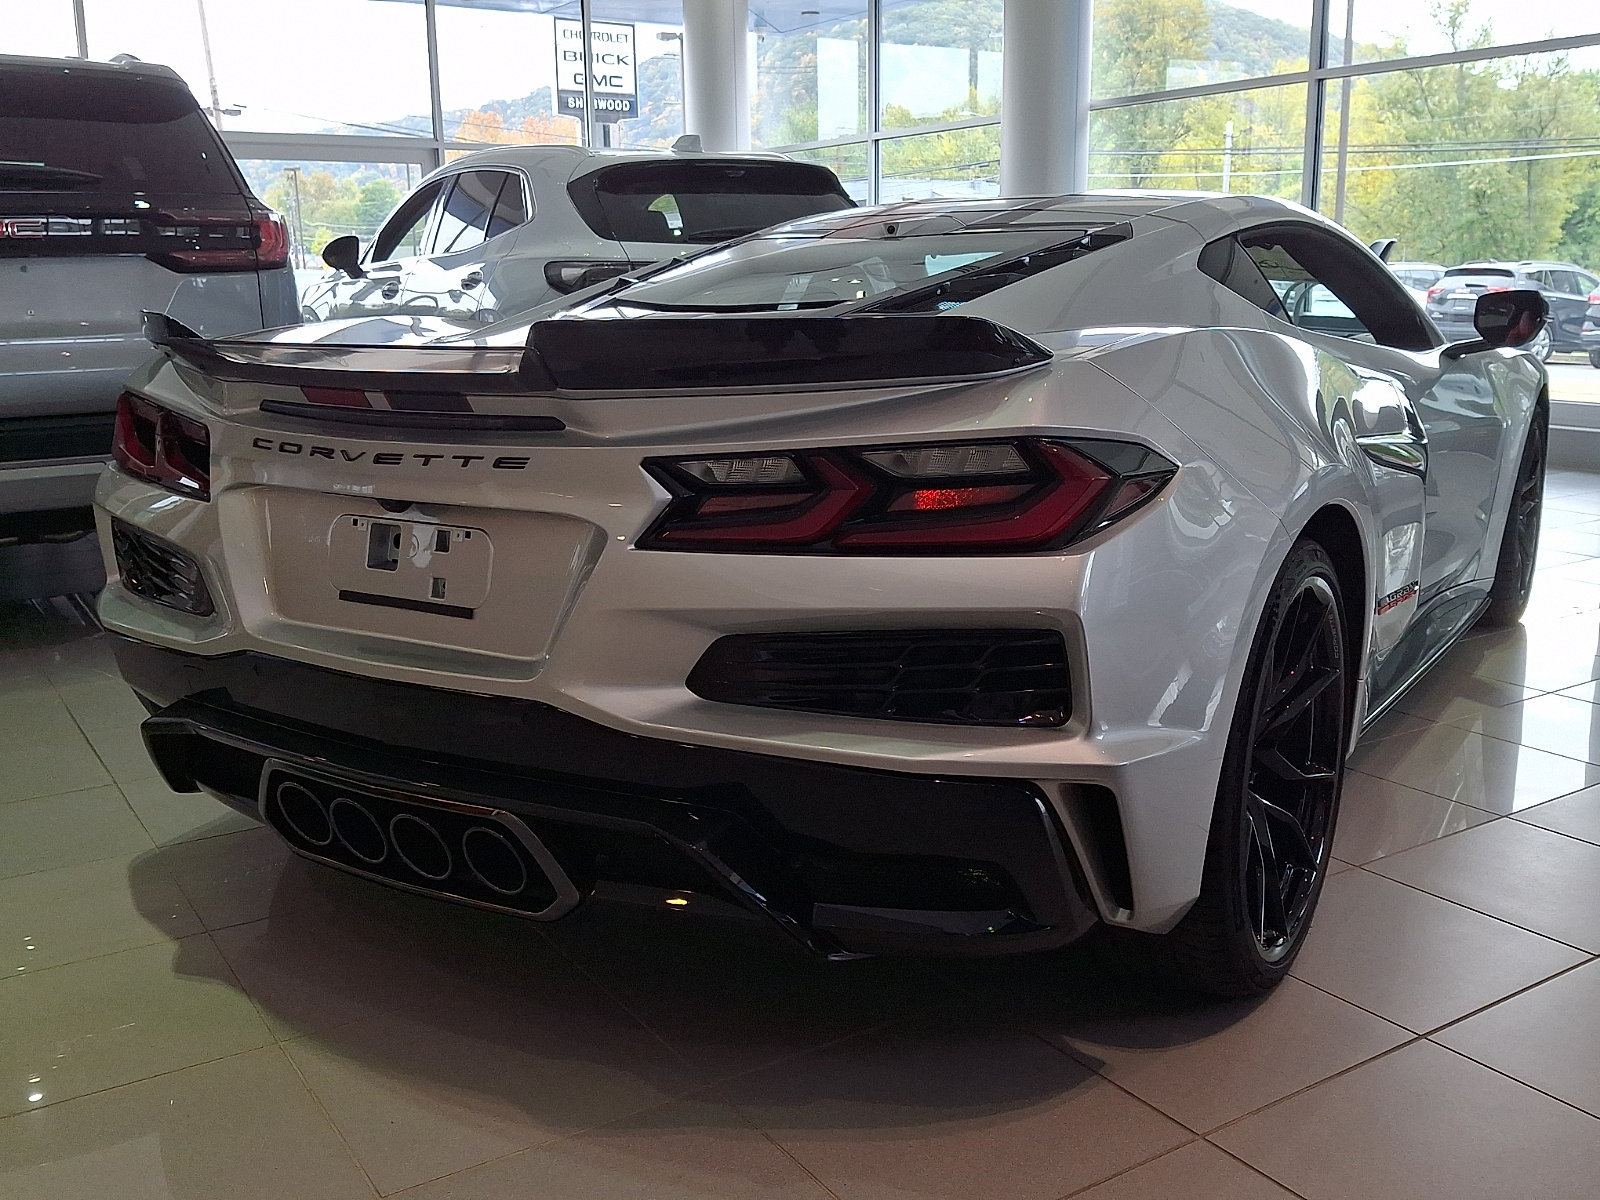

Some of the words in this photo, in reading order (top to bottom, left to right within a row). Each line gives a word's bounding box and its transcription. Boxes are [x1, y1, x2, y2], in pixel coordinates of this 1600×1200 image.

[562, 28, 629, 43] CHROLET
[573, 73, 623, 87] GMC
[567, 97, 631, 112] SHWOOD
[252, 437, 531, 470] CORVETTE
